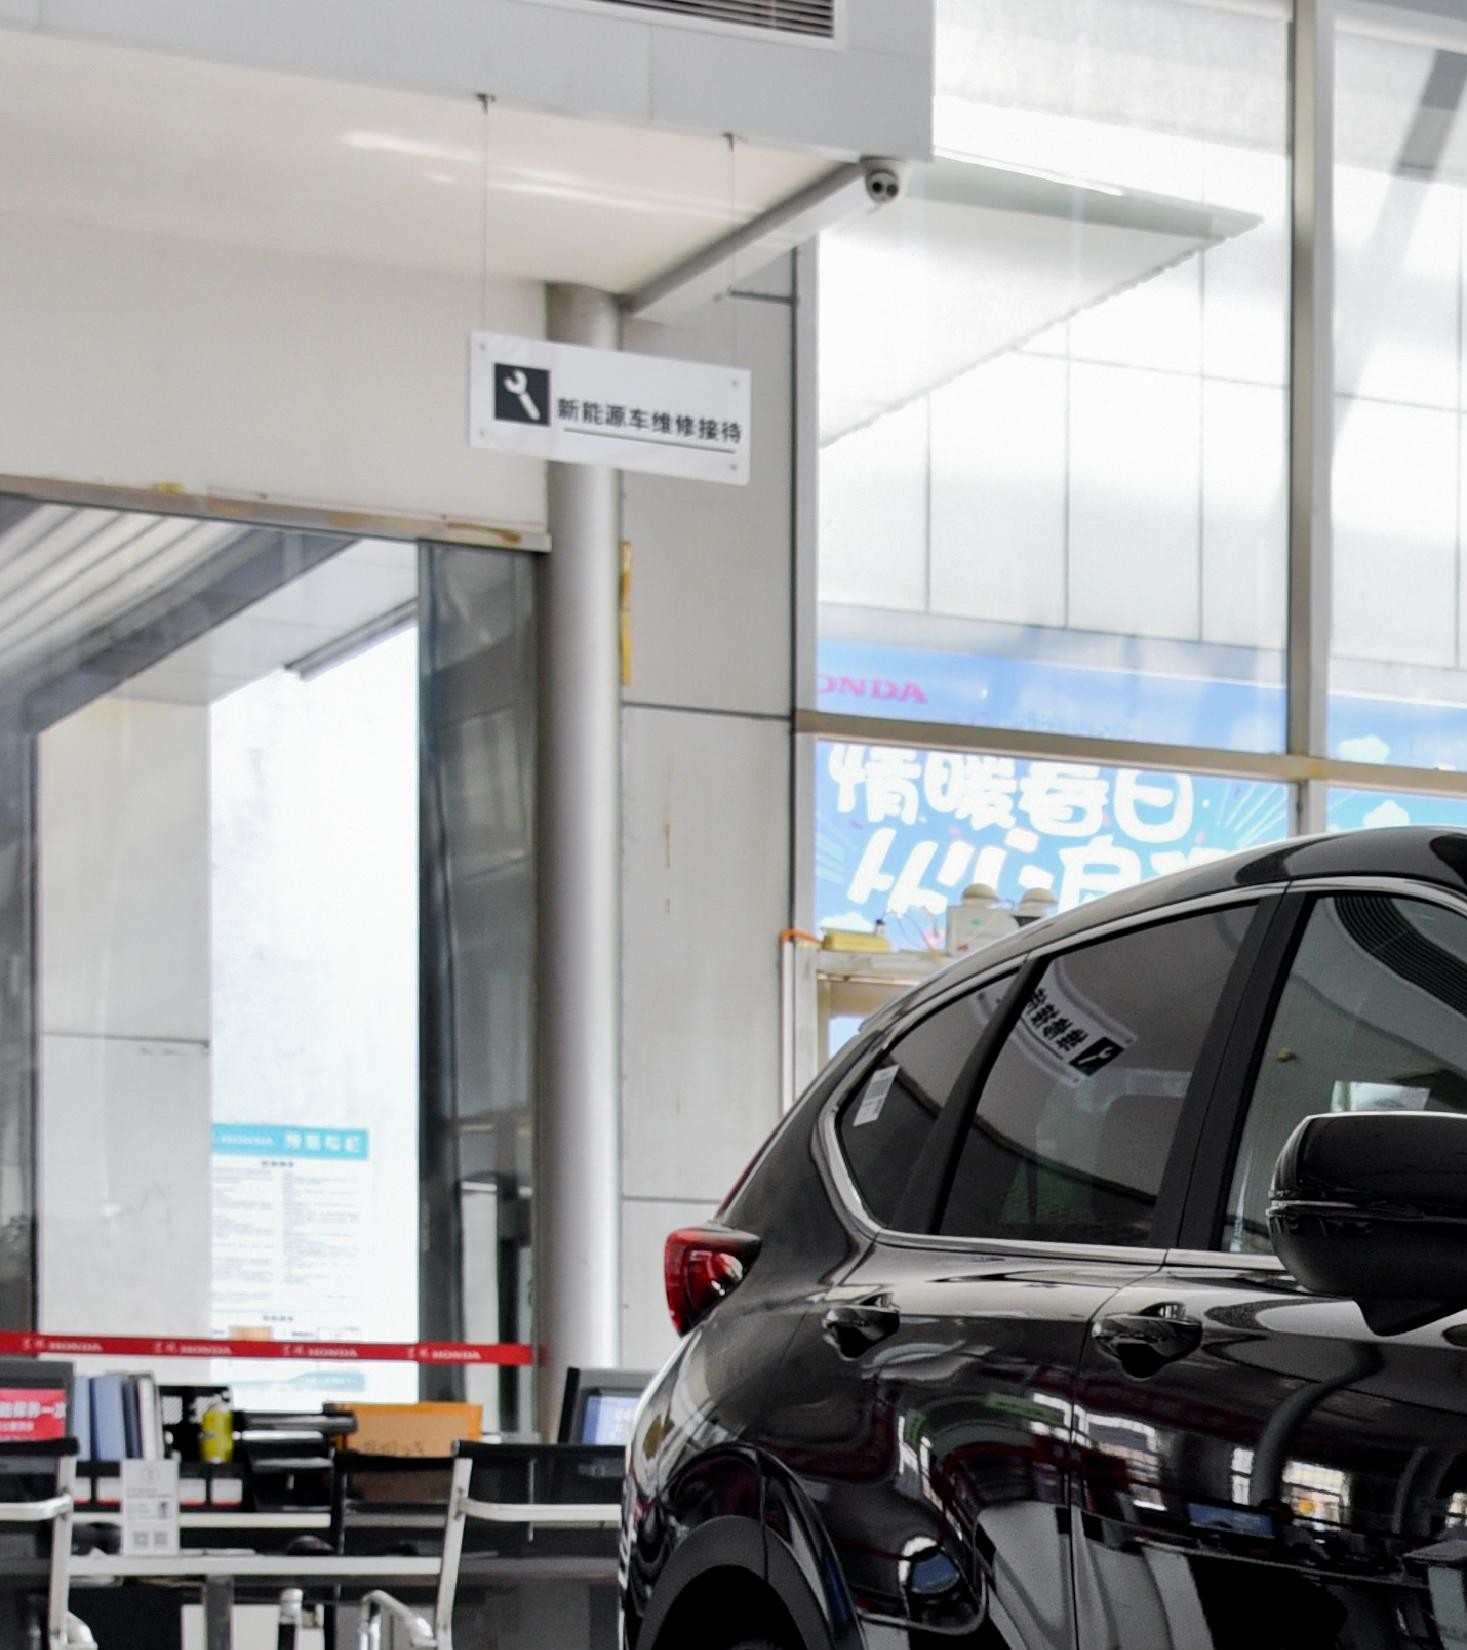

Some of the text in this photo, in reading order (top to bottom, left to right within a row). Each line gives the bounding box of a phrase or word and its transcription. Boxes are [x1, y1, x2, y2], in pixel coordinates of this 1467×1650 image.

[557, 397, 743, 444] 新能源车维修接待
